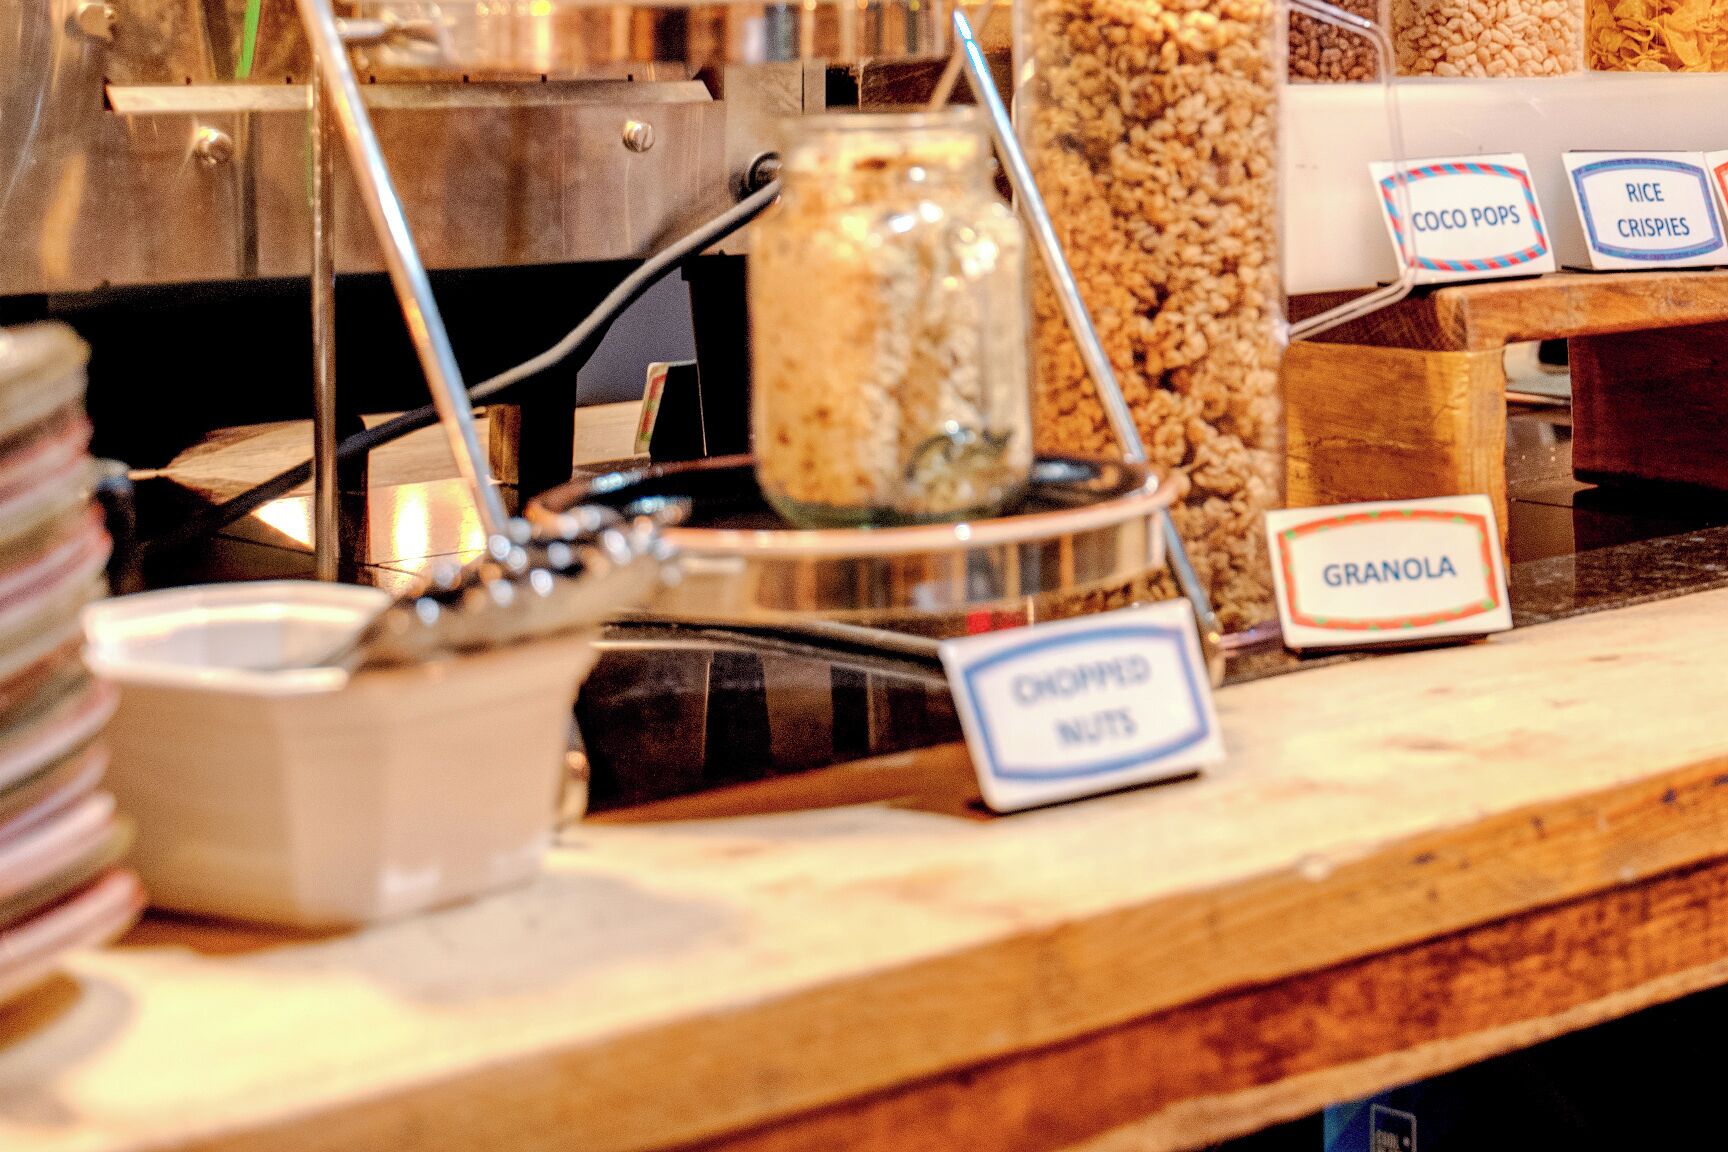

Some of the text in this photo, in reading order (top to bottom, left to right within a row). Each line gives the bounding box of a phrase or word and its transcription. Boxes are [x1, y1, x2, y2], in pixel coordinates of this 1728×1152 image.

[1625, 182, 1665, 203] RICE
[1411, 204, 1521, 233] COCO POPS
[1617, 216, 1691, 239] CRISPIES
[1322, 555, 1457, 588] GRANOLA
[1011, 654, 1152, 707] CHOPPED
[1054, 707, 1137, 746] NUTS
